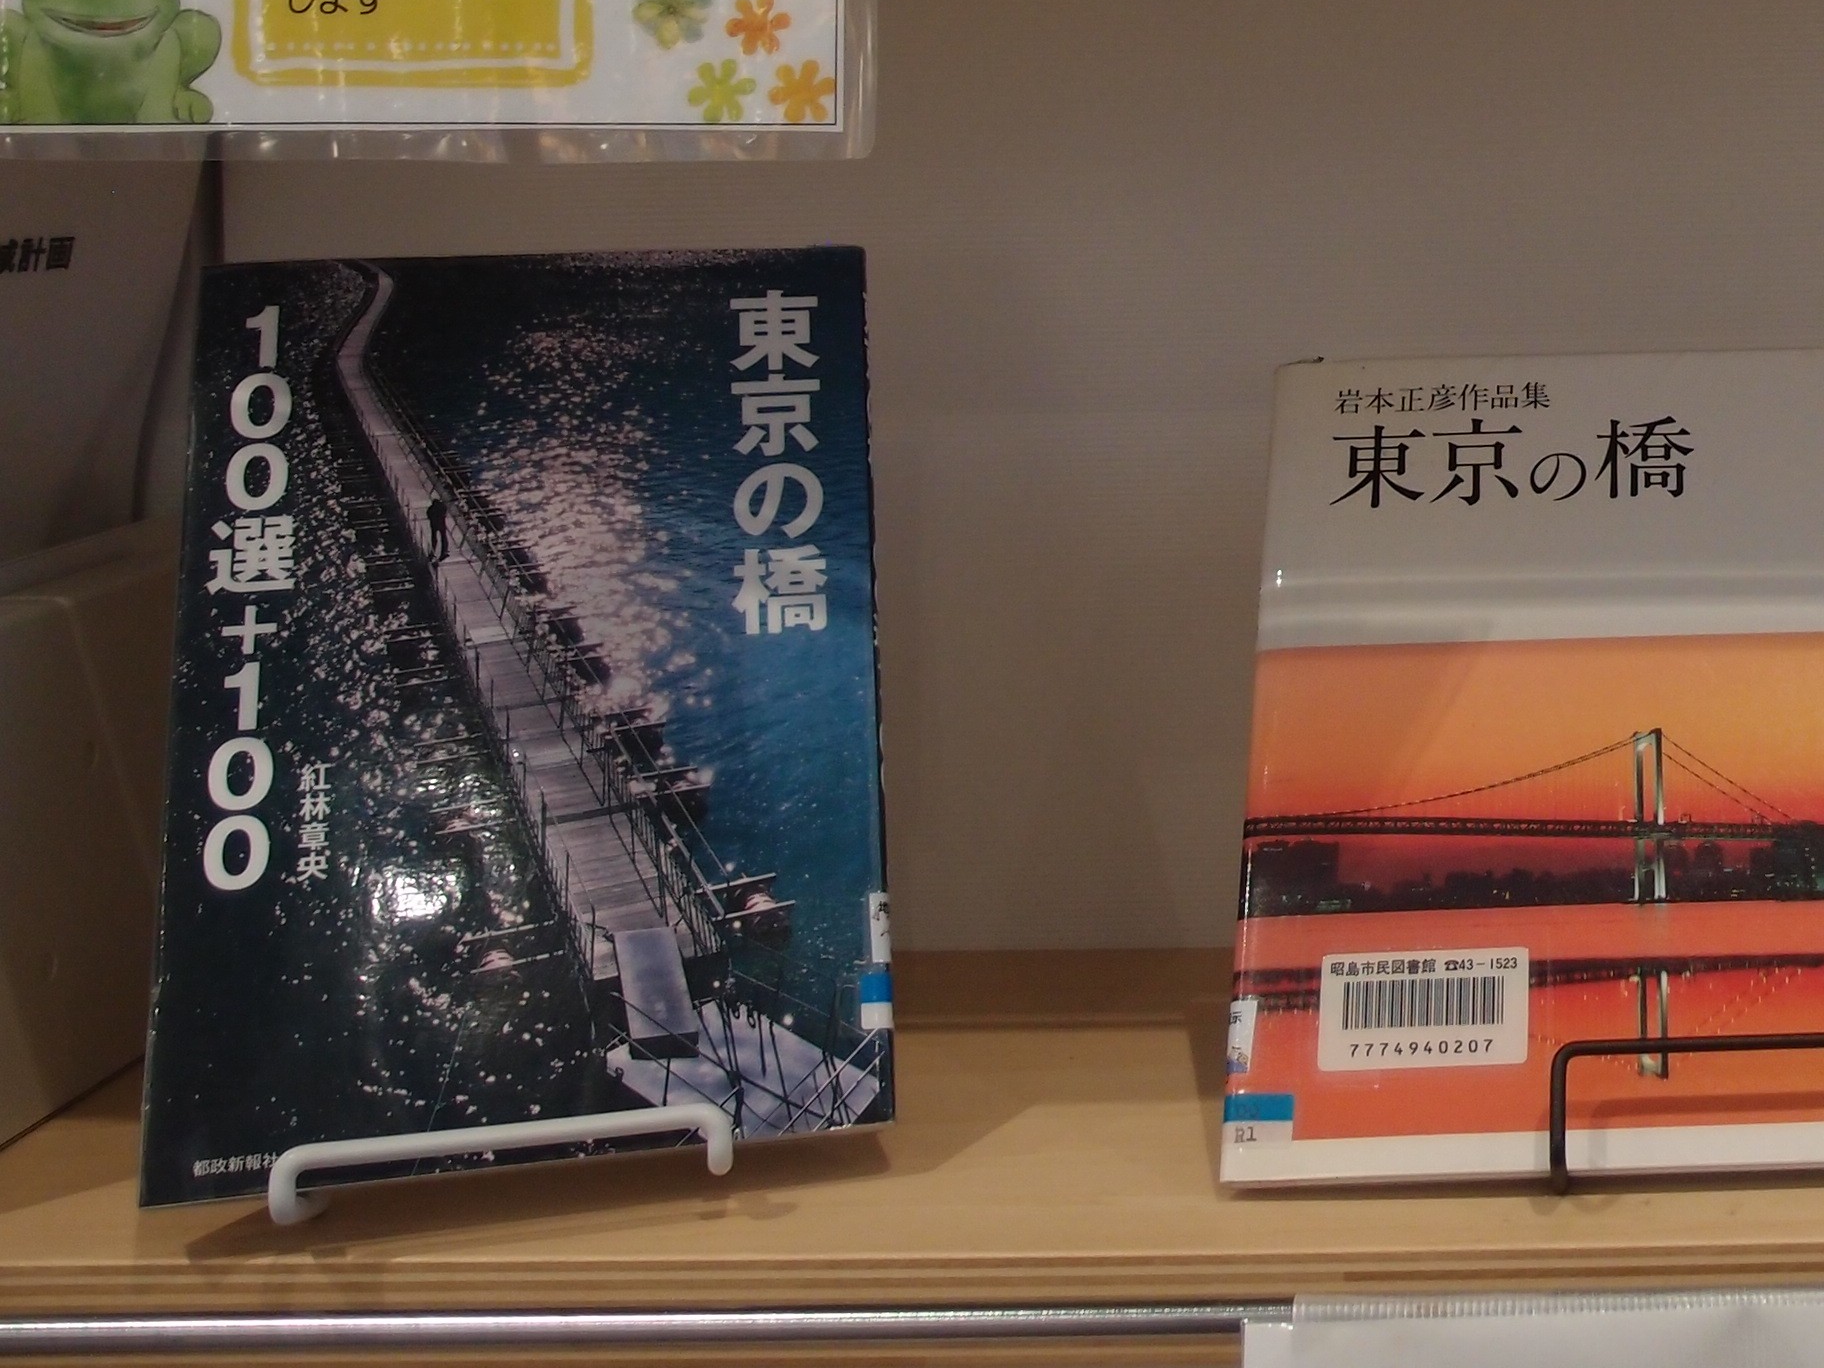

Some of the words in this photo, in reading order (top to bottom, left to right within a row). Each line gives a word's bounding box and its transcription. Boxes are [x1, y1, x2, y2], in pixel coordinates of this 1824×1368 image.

[1334, 381, 1552, 415] 岩本正彦作品集
[729, 288, 828, 637] 東京の橋
[1329, 415, 1695, 510] 東京の橋
[201, 305, 298, 892] 100選+100
[296, 762, 332, 882] 紅林章央
[1348, 1036, 1495, 1060] 7774940207
[193, 1150, 279, 1179] 都政新報社
